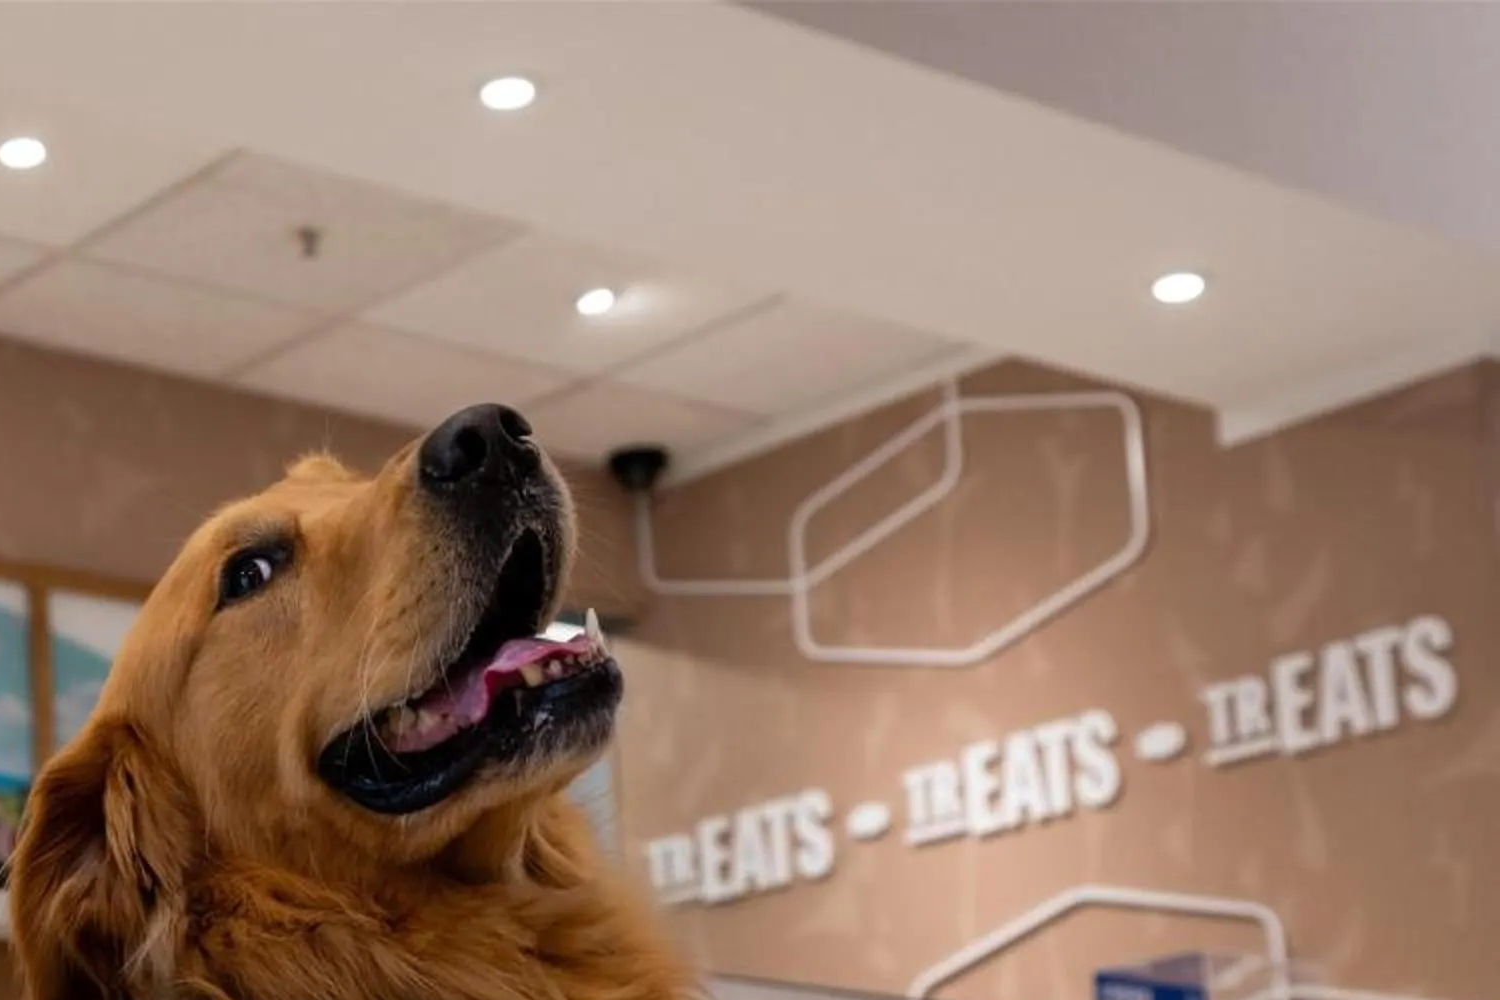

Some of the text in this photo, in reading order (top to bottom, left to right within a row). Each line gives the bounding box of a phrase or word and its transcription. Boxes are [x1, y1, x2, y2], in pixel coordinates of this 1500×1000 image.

[647, 613, 1458, 904] TREATS TREATS TREATS
